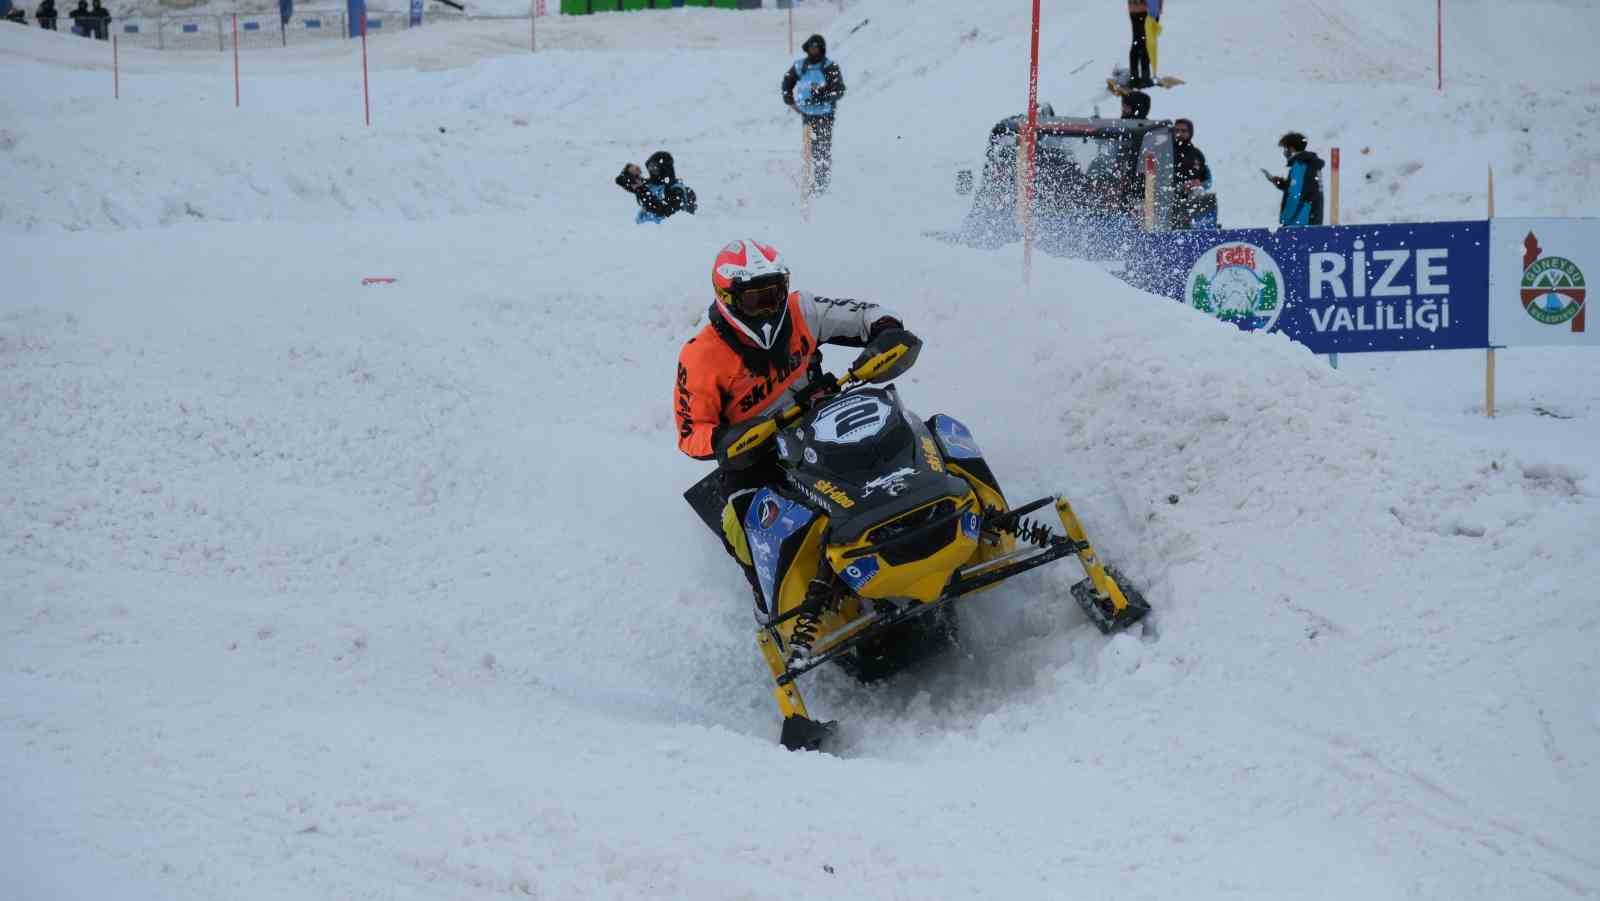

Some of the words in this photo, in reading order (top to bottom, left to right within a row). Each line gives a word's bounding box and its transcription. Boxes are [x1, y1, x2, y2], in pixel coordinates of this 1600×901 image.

[1309, 240, 1450, 299] RİZE
[1310, 299, 1449, 333] VALİLİĞİ
[834, 402, 880, 439] 2
